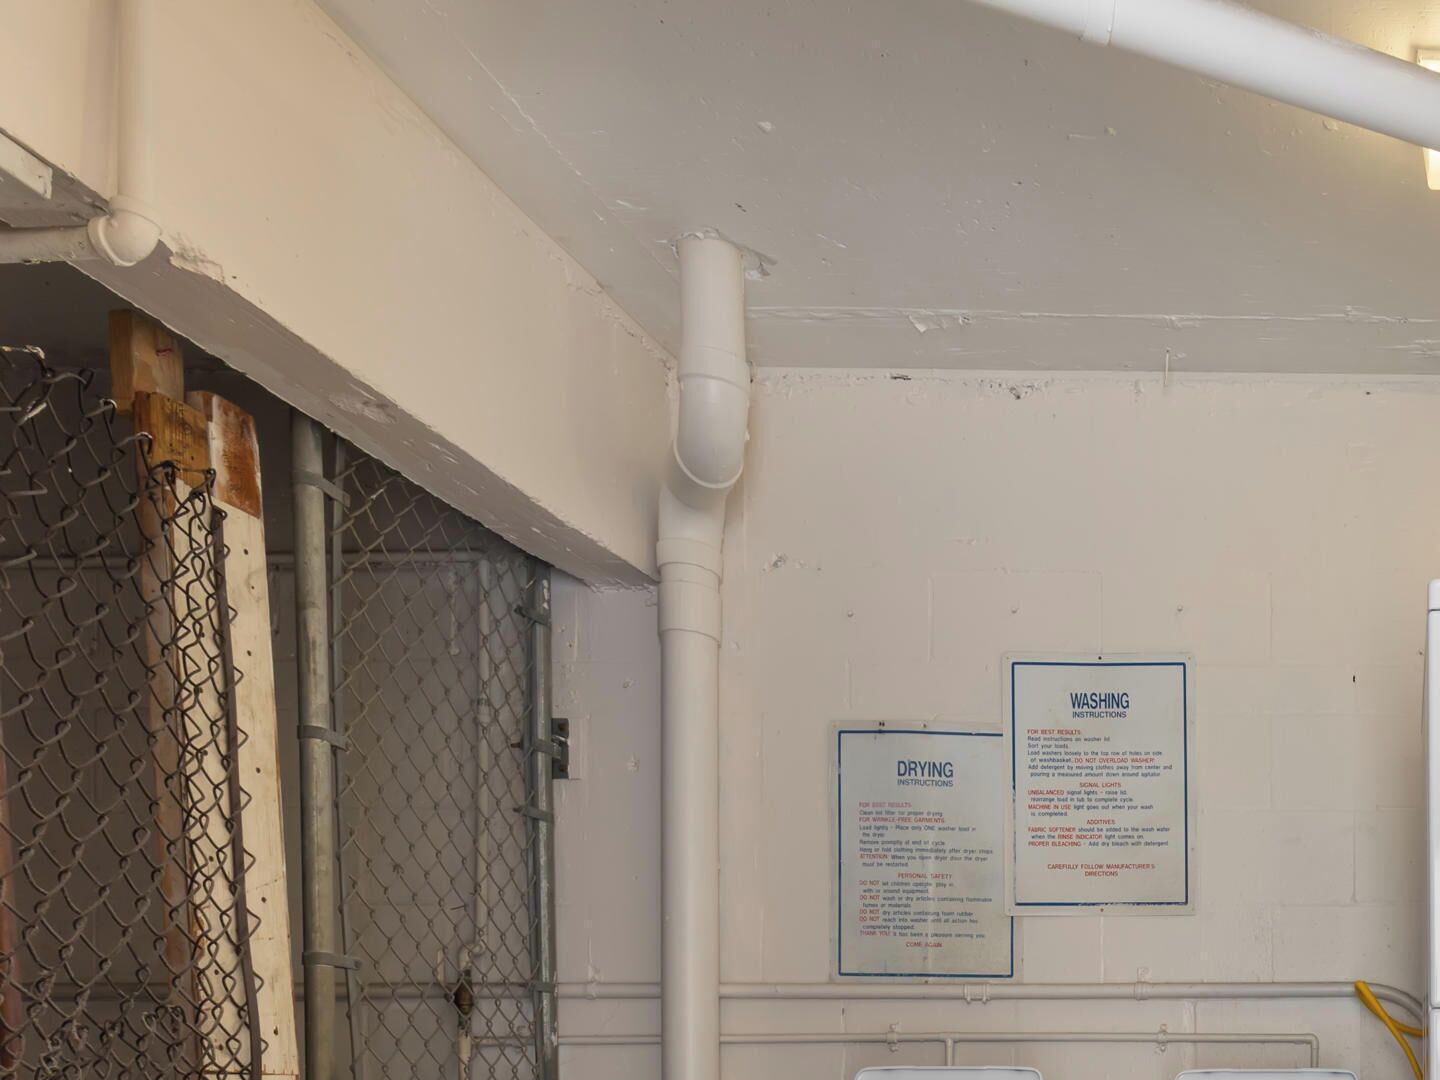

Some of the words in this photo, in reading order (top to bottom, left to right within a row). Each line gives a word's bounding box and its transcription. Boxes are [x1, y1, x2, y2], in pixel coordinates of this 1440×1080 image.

[1070, 692, 1130, 709] WASHING
[897, 760, 954, 778] DRYING
[897, 778, 954, 788] INSTRUCTIONS
